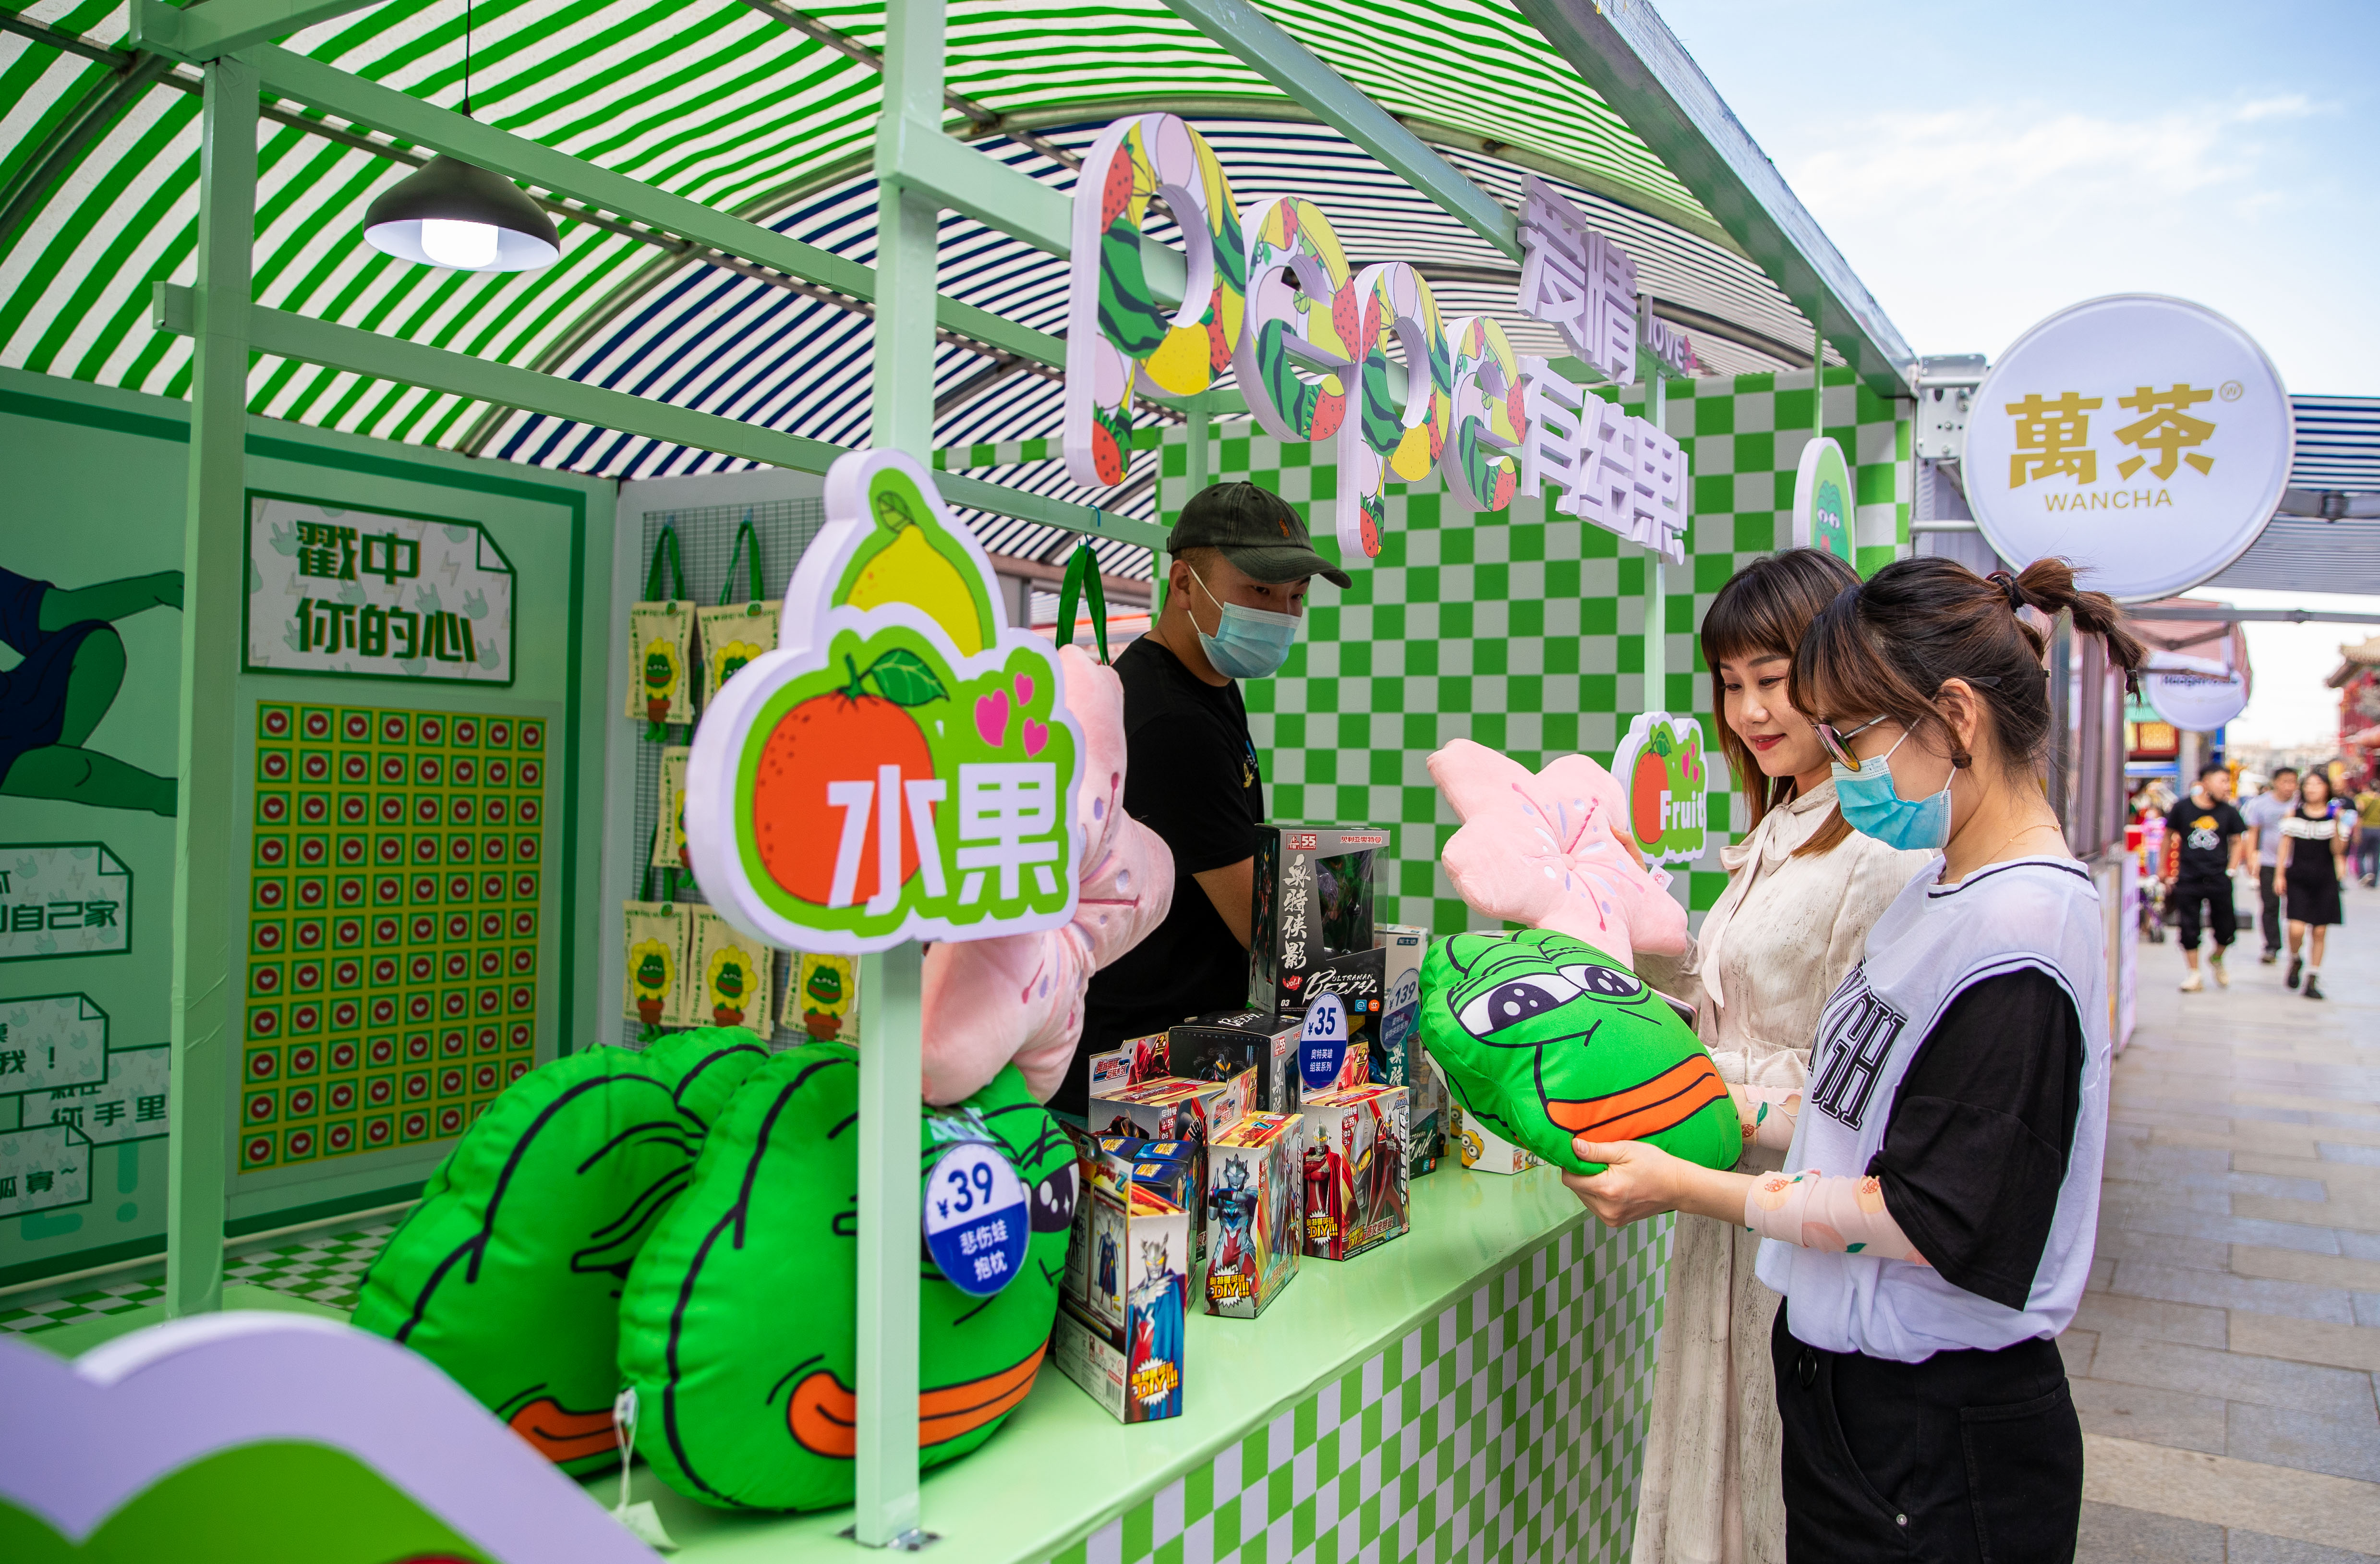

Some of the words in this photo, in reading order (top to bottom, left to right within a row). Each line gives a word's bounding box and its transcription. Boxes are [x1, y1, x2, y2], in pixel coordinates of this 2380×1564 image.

[1517, 173, 1638, 387] 爱情
[2005, 383, 2217, 489] 萬茶
[2044, 489, 2173, 512] WANCHA
[295, 520, 421, 585] 戳中
[295, 597, 476, 663] 你的心
[1660, 789, 1704, 831] Fruit
[827, 763, 1059, 917] 水果
[1302, 836, 1316, 847] 55
[1341, 836, 1382, 844] 贝利亚奥特曼
[0, 900, 119, 934] 自己家
[1332, 973, 1373, 982] ULTRAMAN
[1389, 981, 1416, 1010] ¥139
[1308, 1006, 1337, 1036] ¥35
[1311, 1049, 1333, 1059] 奥特英雄
[1310, 1062, 1331, 1072] 组装系列
[1162, 1106, 1177, 1118] 奥特曼
[1168, 1118, 1174, 1127] 55
[1343, 1106, 1357, 1117] 奥特曼
[1349, 1116, 1354, 1125] 55
[937, 1162, 993, 1219] ¥39
[1306, 1216, 1335, 1227] 奥特曼英雄
[1308, 1223, 1338, 1238] DIY!!!
[959, 1219, 1009, 1256] 悲伤蛙
[973, 1250, 1008, 1282] 抱枕
[1209, 1274, 1245, 1285] 奥特曼英雄
[1212, 1281, 1250, 1298] DIY!!!
[1135, 1369, 1179, 1399] DIY!!!
